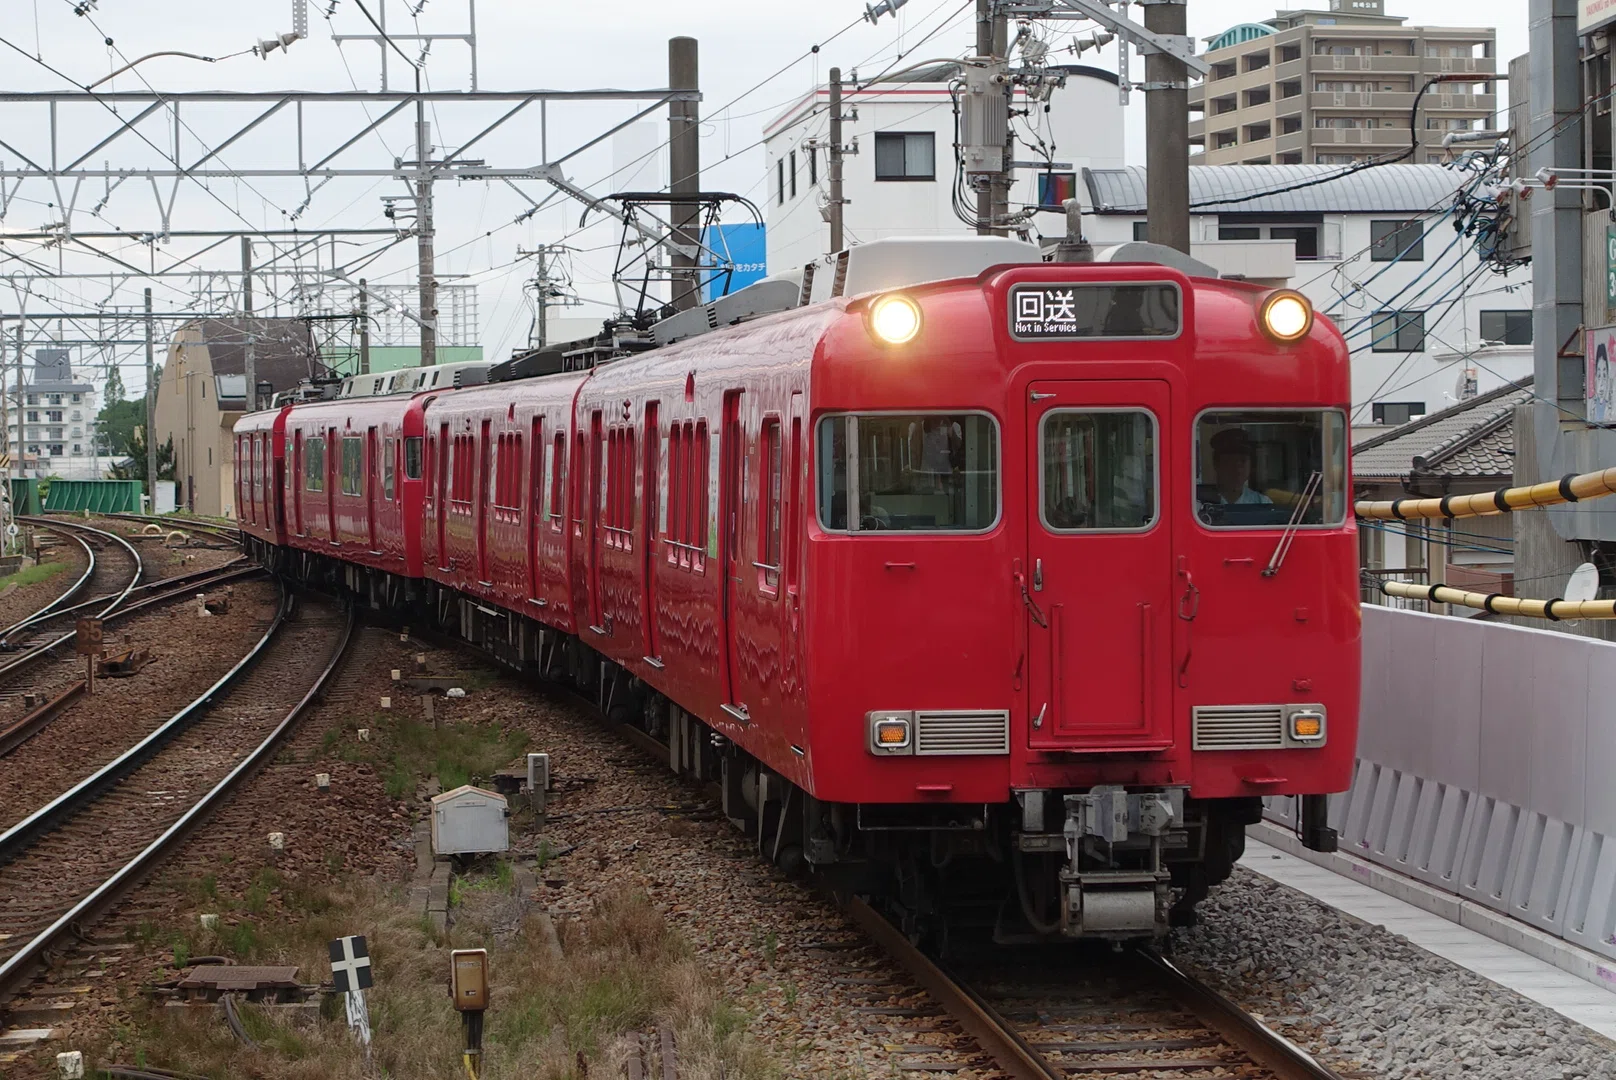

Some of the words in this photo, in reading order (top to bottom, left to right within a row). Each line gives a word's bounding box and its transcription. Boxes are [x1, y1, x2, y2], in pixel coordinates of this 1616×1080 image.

[1016, 290, 1076, 322] 回送
[1015, 322, 1032, 333] Not
[1033, 322, 1042, 333] in
[1043, 322, 1077, 333] Service
